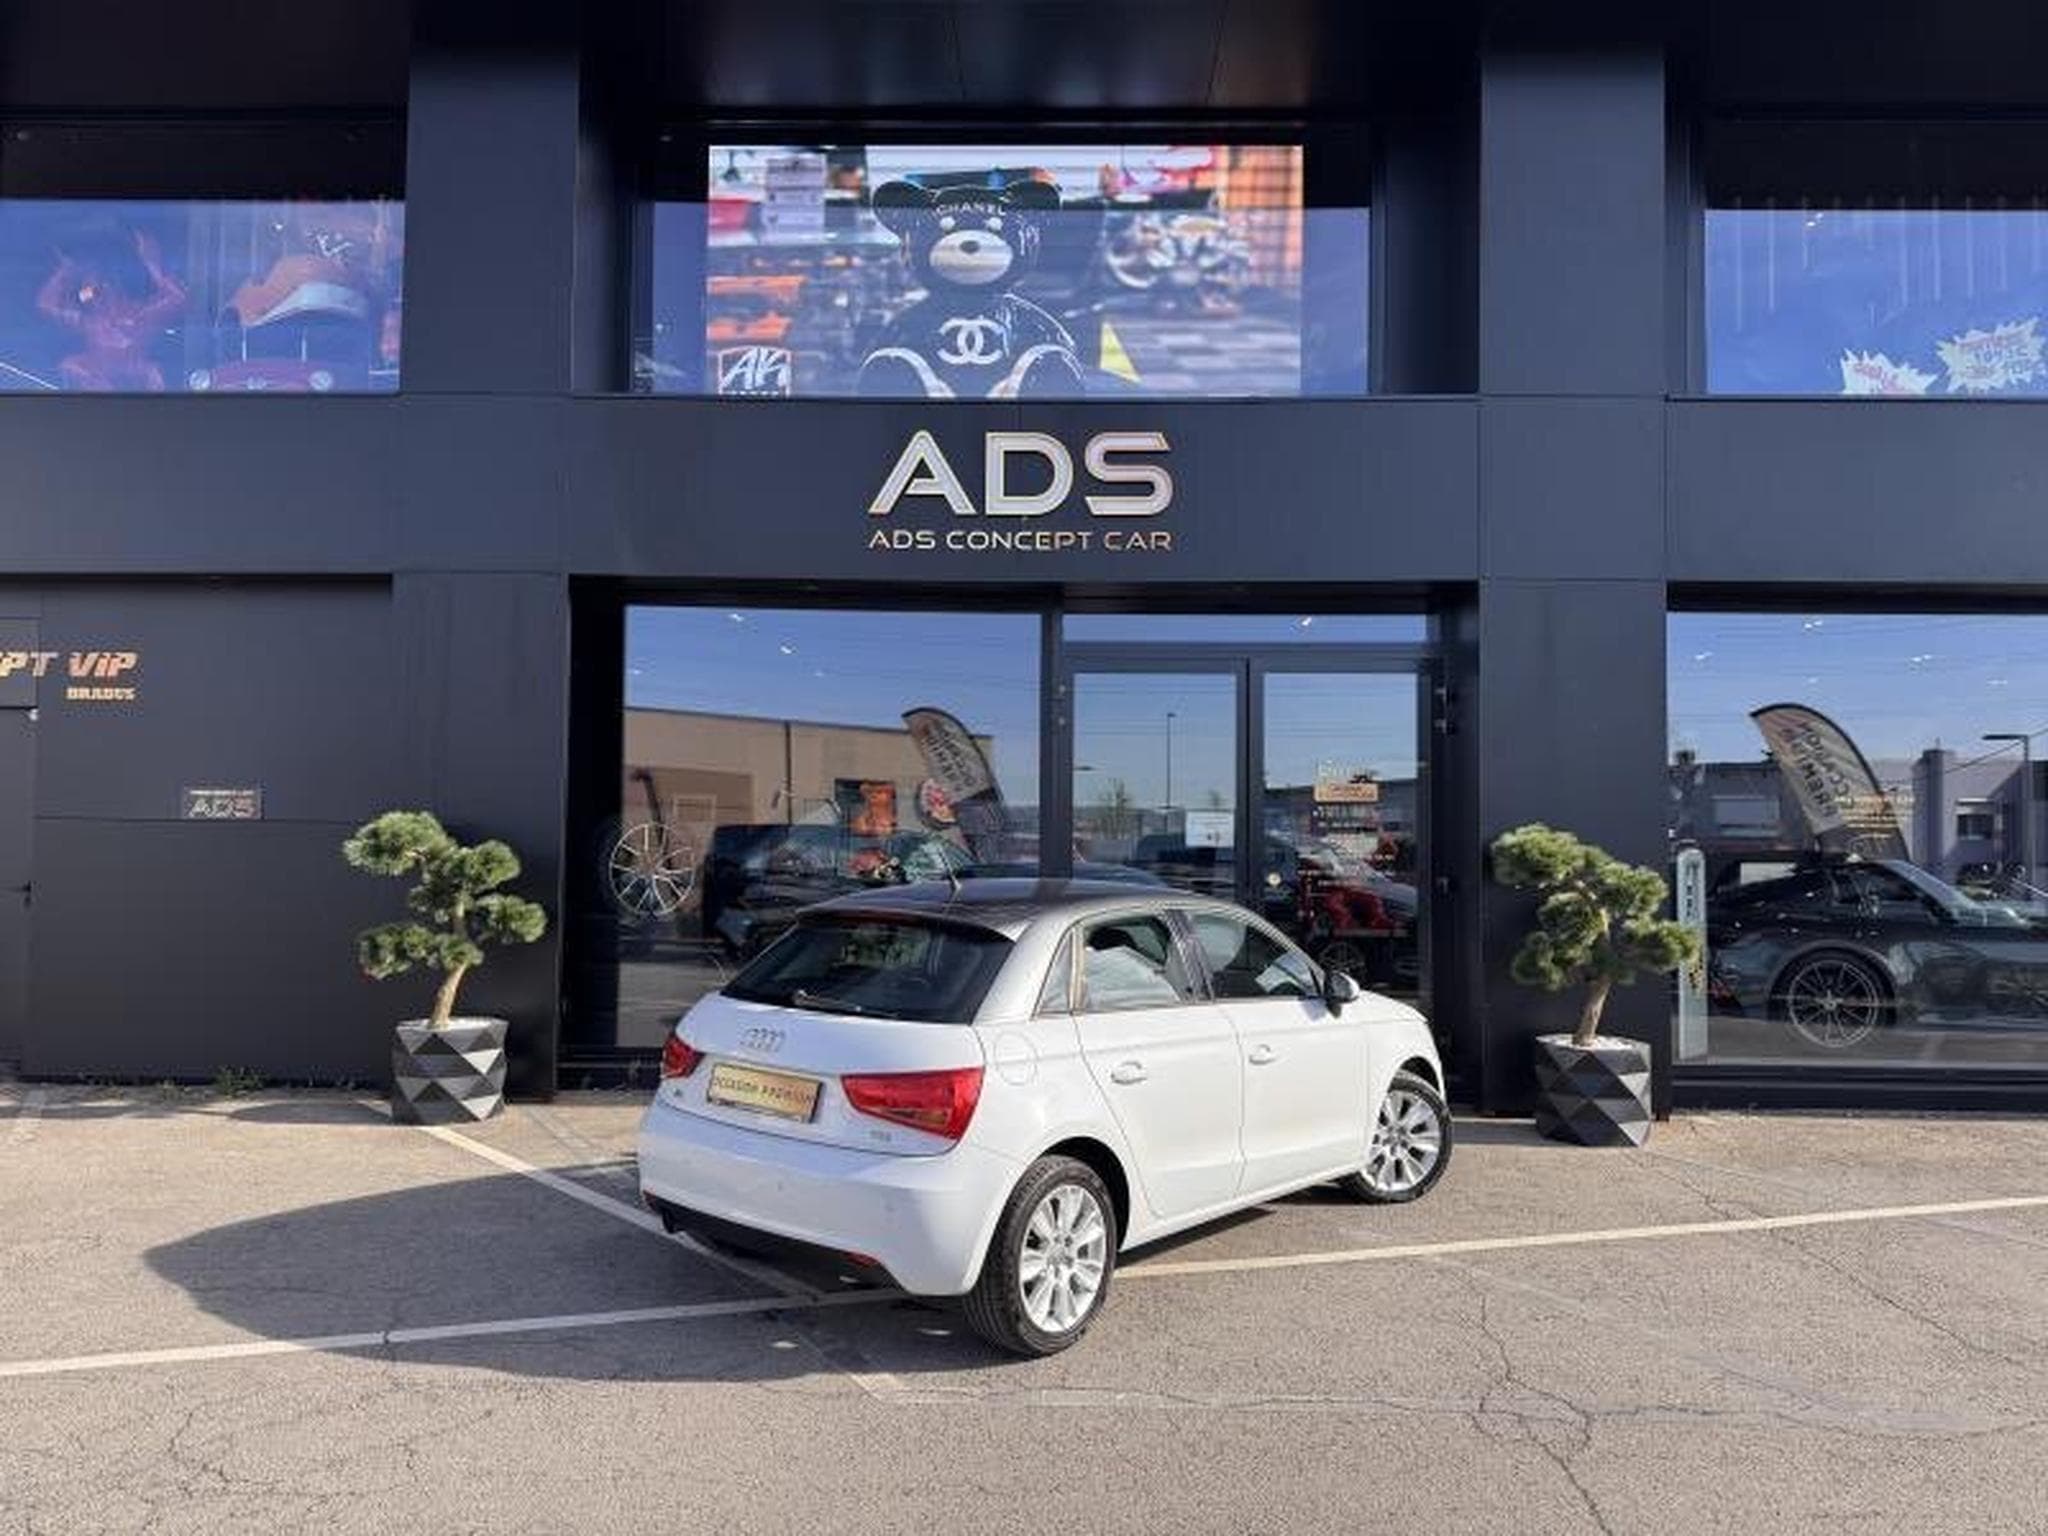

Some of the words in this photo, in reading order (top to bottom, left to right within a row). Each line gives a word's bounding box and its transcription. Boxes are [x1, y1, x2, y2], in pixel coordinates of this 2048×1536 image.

[934, 201, 1007, 217] CHANEL
[867, 429, 1174, 516] ADS
[868, 529, 937, 550] ADS
[945, 529, 1093, 551] CONCEPT
[1103, 530, 1172, 551] CAR
[0, 652, 59, 677] PT
